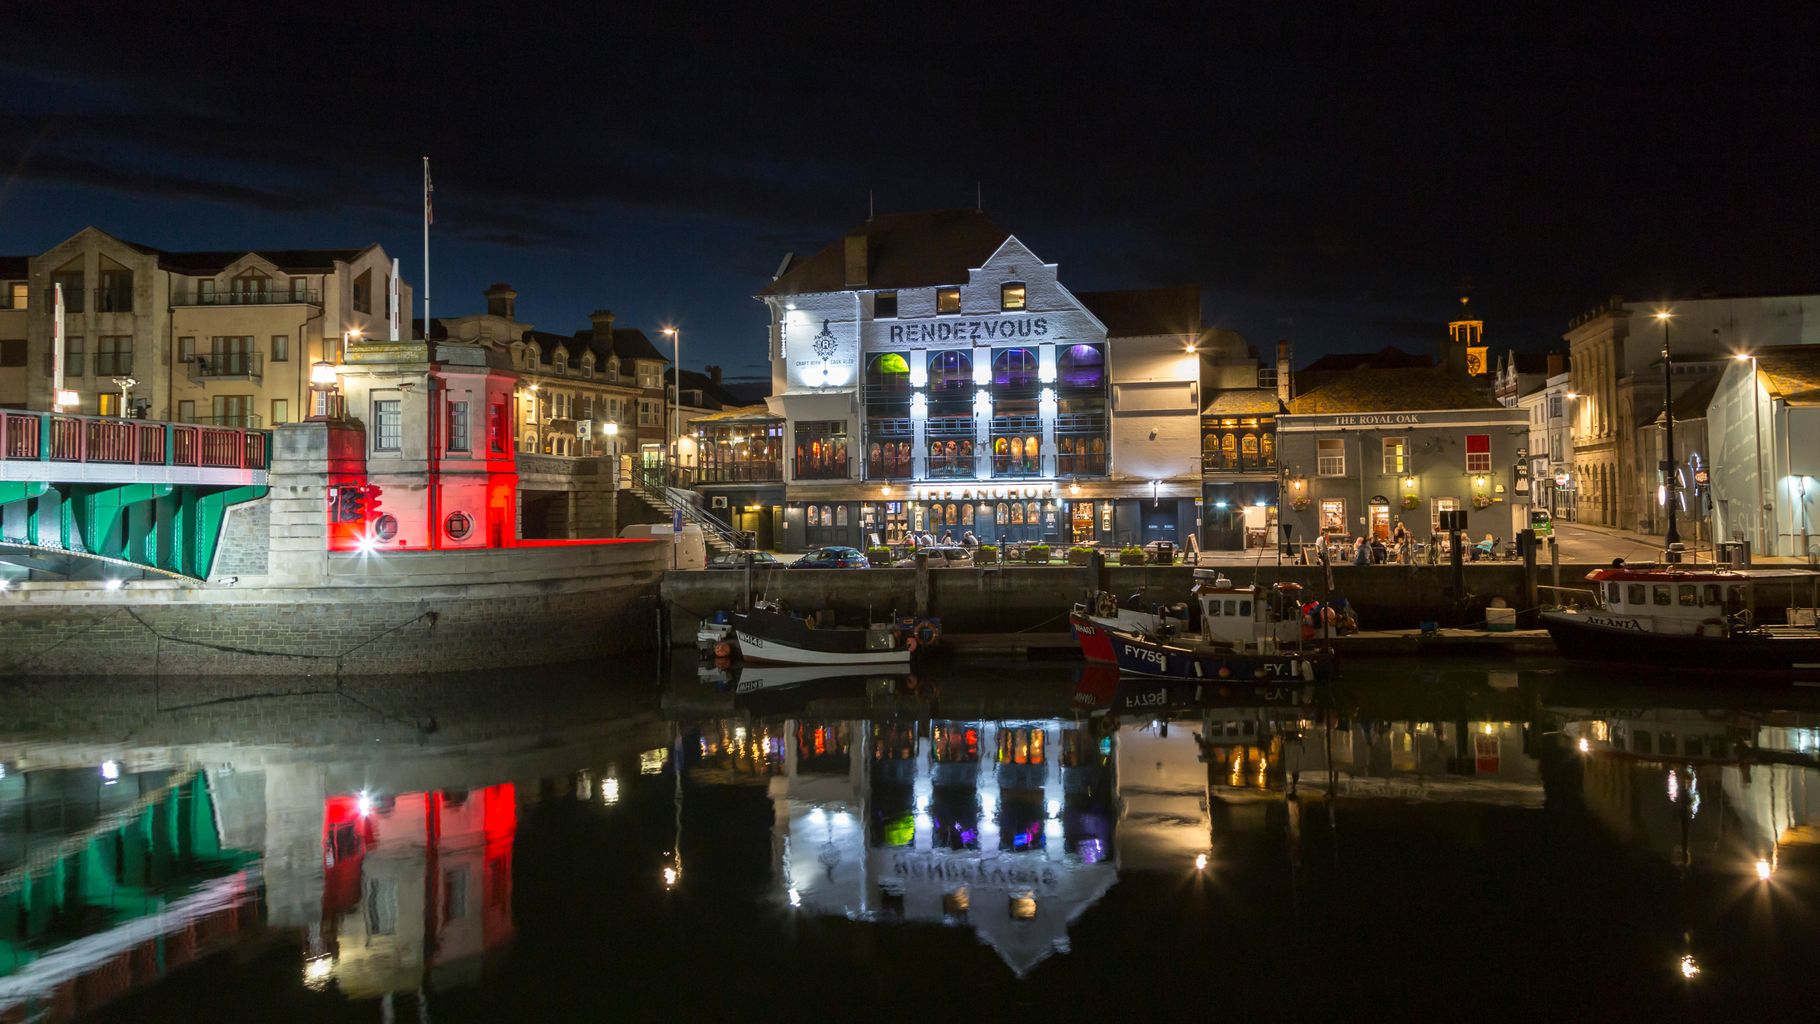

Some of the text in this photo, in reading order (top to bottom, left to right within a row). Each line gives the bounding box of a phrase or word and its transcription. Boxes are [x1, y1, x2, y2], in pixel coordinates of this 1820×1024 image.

[890, 317, 1049, 343] RENDEZVOUS
[1335, 414, 1418, 424] THE ROYAL OAK
[961, 487, 1053, 501] ANCHOR
[1586, 616, 1649, 632] ATLANTA
[738, 633, 763, 648] WH148
[1124, 644, 1165, 664] FY759
